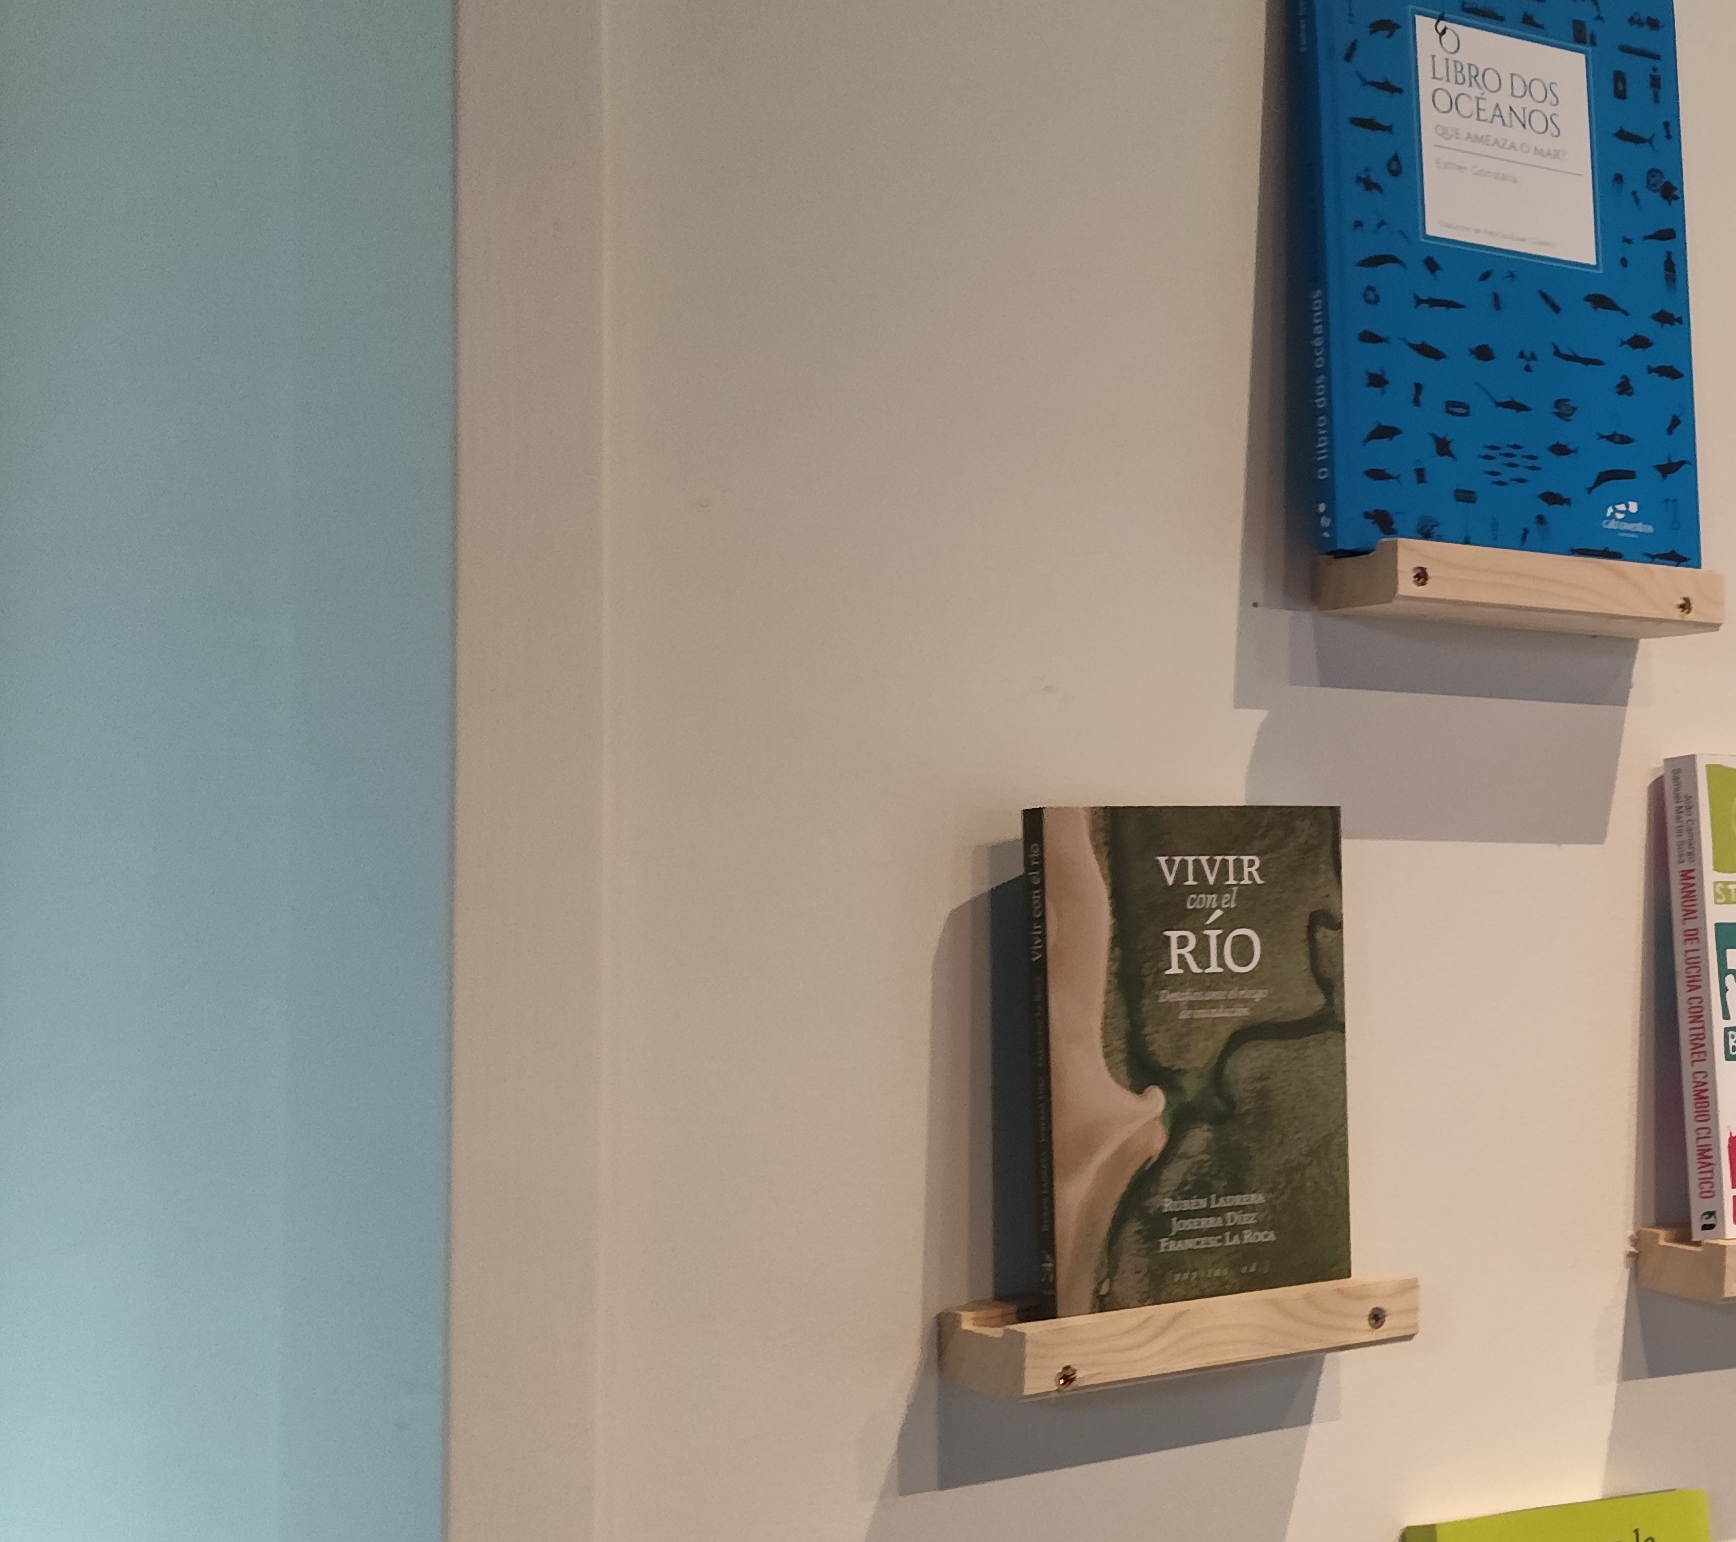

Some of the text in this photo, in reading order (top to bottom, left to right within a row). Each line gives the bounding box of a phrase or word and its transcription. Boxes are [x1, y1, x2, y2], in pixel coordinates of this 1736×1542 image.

[1430, 54, 1560, 107] LIBRO DOS
[1431, 87, 1561, 138] OCÉANOS
[1434, 123, 1461, 141] QUE
[1465, 131, 1518, 152] AMEAZA
[1520, 142, 1531, 154] O
[1313, 374, 1328, 409] dos
[1314, 415, 1330, 462] libro
[1155, 855, 1265, 886] VIVIR
[1027, 890, 1042, 916] con
[1186, 886, 1239, 909] con el
[1028, 920, 1044, 963] Vivir
[1162, 909, 1262, 975] RÍO
[1678, 868, 1717, 1200] MANUAL DE LUCHA CAMBIO CLIMÁTICO
